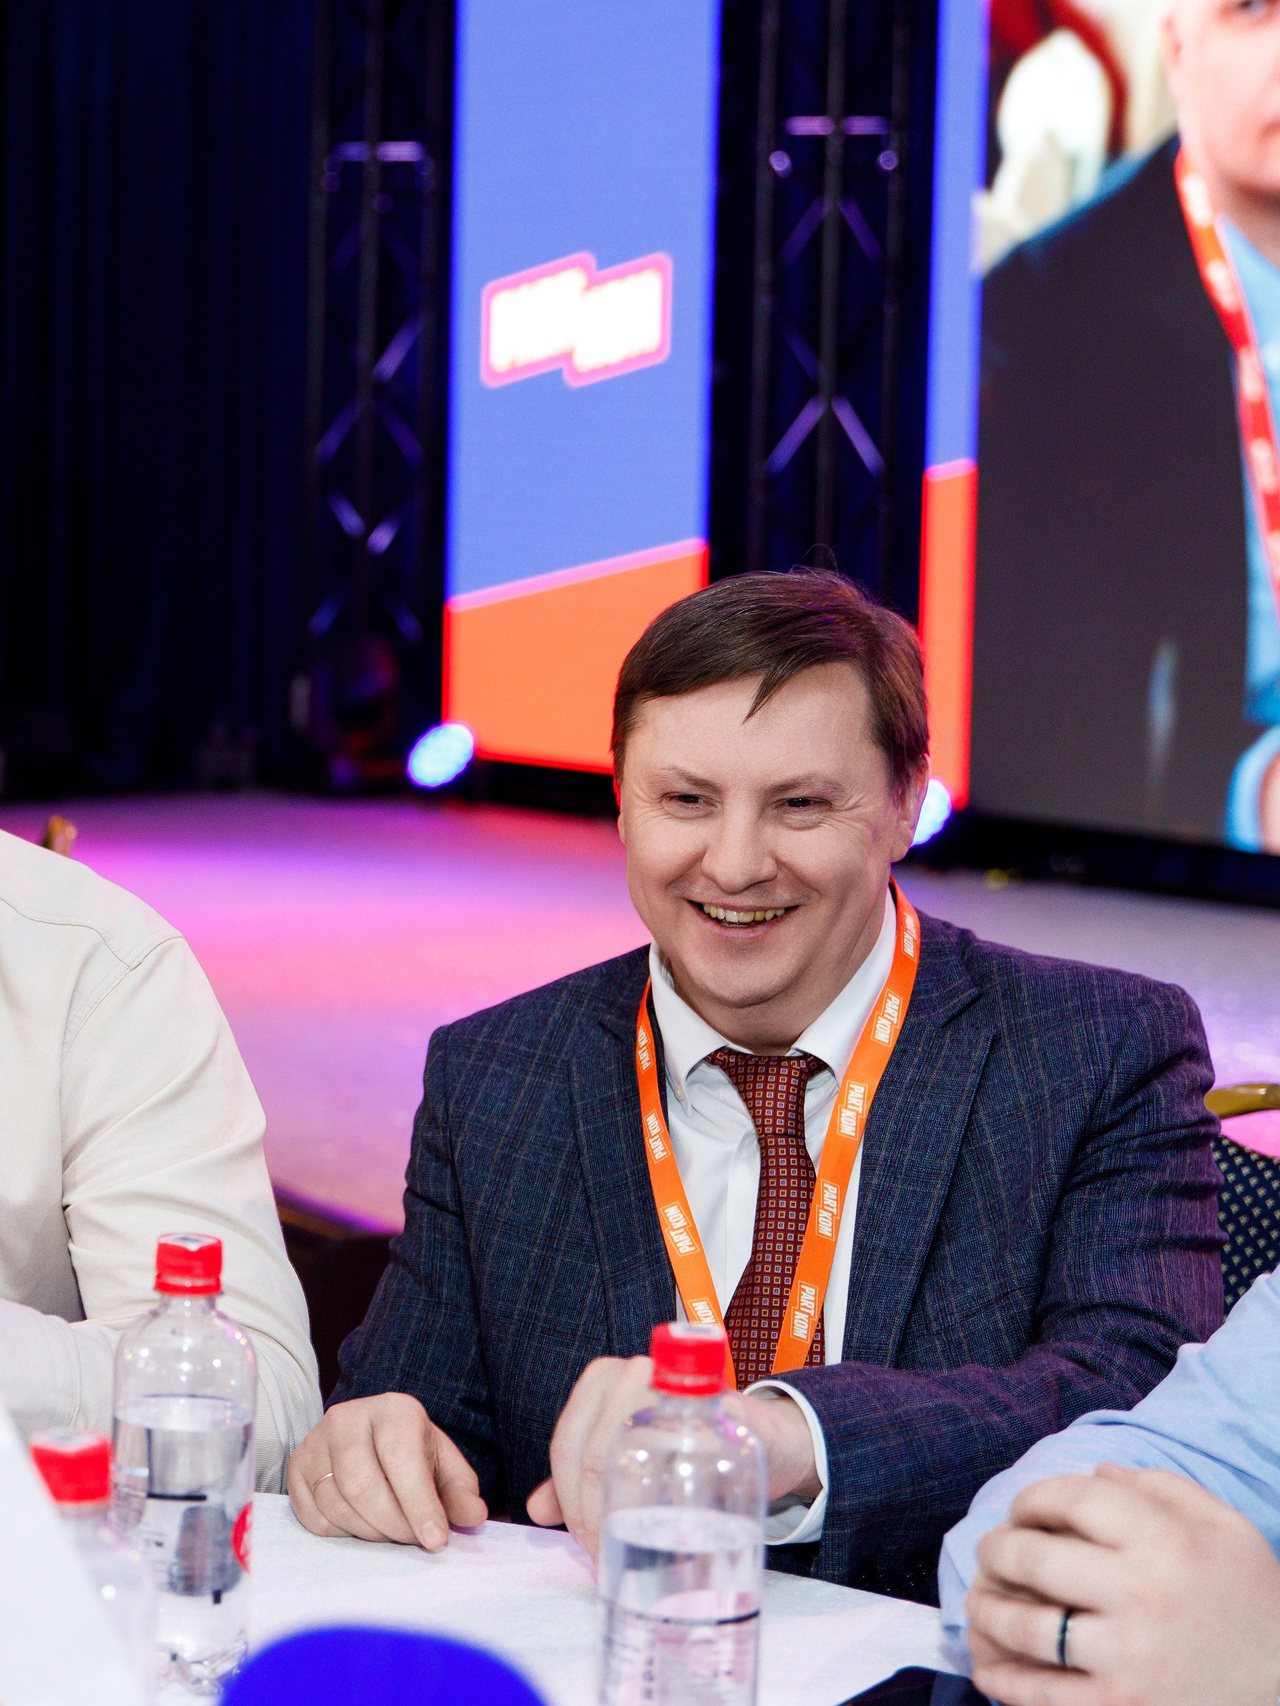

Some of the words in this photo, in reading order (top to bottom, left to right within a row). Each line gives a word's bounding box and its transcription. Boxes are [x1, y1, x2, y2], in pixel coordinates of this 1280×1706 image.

[903, 937, 915, 958] KOM
[884, 993, 901, 1024] PART
[874, 1017, 891, 1044] KOM
[638, 1046, 652, 1071] PART
[848, 1083, 864, 1114] PART
[645, 1112, 661, 1137] KOM
[840, 1109, 857, 1137] KOM
[649, 1134, 668, 1160] PART
[824, 1183, 838, 1215] PART
[663, 1205, 688, 1230] KOM
[818, 1208, 833, 1238] KOM
[670, 1228, 696, 1254] PART
[800, 1284, 816, 1317] PART
[793, 1310, 809, 1340] KOM
